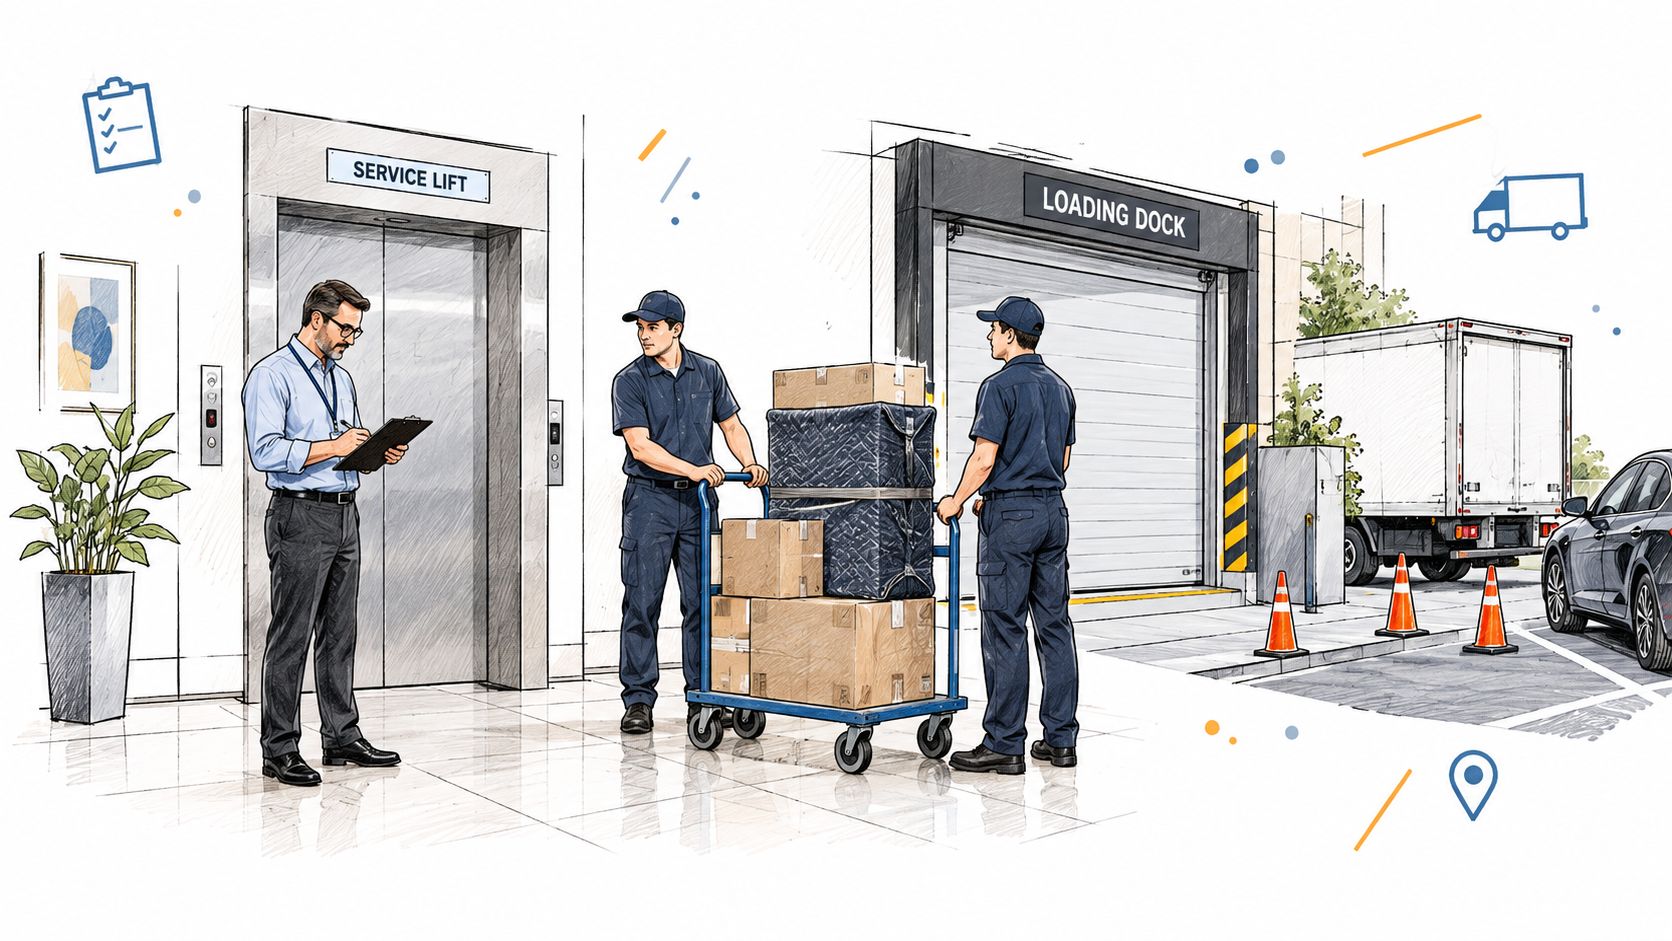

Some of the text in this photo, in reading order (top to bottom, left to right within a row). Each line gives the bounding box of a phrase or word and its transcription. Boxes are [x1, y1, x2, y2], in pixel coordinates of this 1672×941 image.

[353, 160, 468, 192] SERVICE LIFT
[1043, 186, 1186, 238] LOADING DOCK
